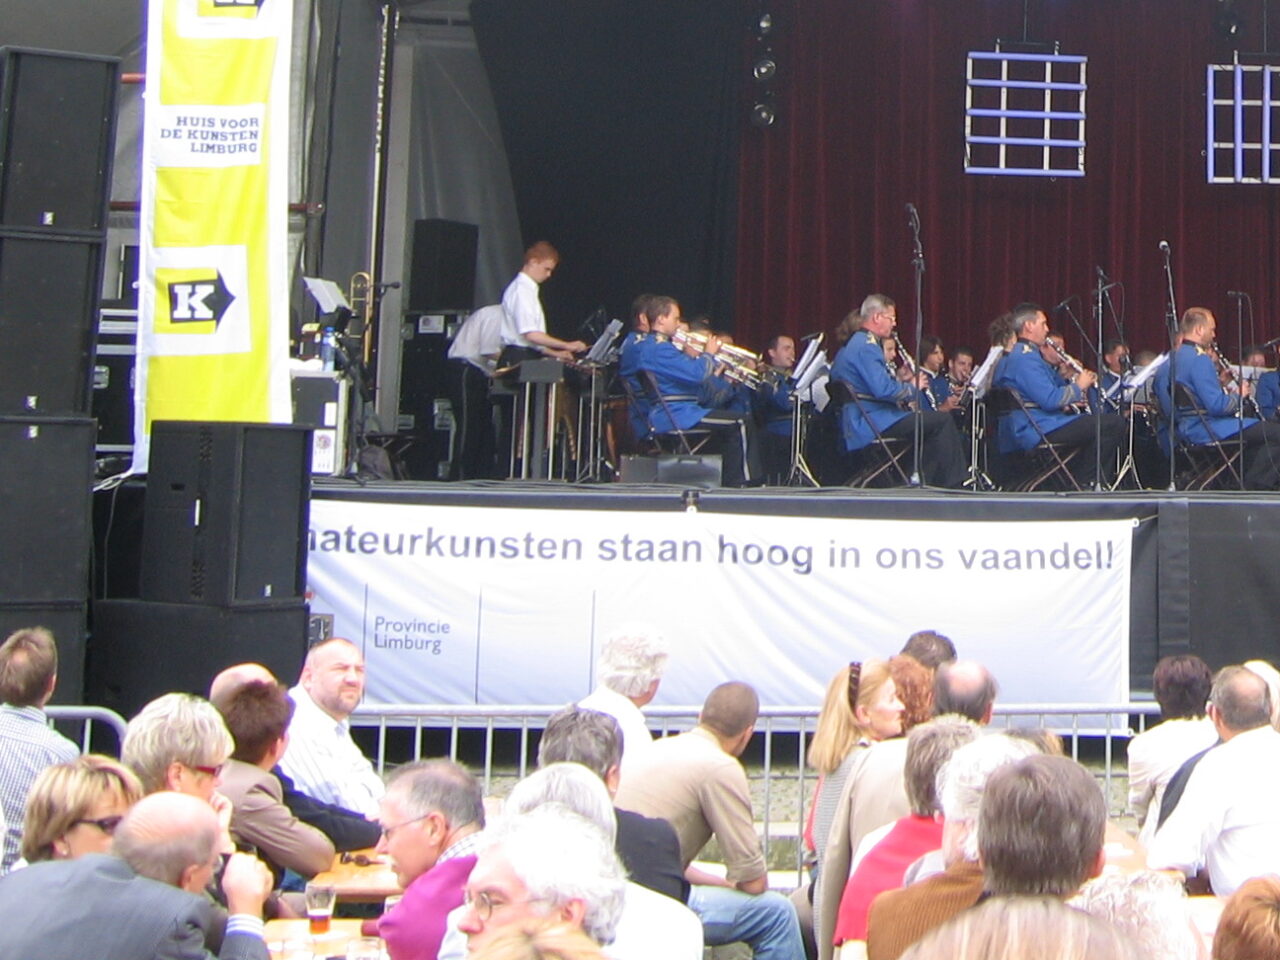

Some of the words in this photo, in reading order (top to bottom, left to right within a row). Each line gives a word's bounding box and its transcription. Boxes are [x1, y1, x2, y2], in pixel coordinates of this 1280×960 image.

[176, 116, 215, 128] HUIS
[220, 118, 259, 129] VOOR
[160, 129, 182, 139] DE
[187, 129, 259, 141] KUNSTEN
[190, 142, 258, 154] LIMBURG
[308, 524, 583, 561] ateurkunsten
[598, 533, 702, 563] staan
[717, 534, 813, 574] hoog
[829, 540, 861, 568] in
[875, 544, 944, 570] ons
[958, 541, 1114, 570] vaandel!
[374, 616, 451, 634] Provincie
[374, 634, 441, 655] Limburg
